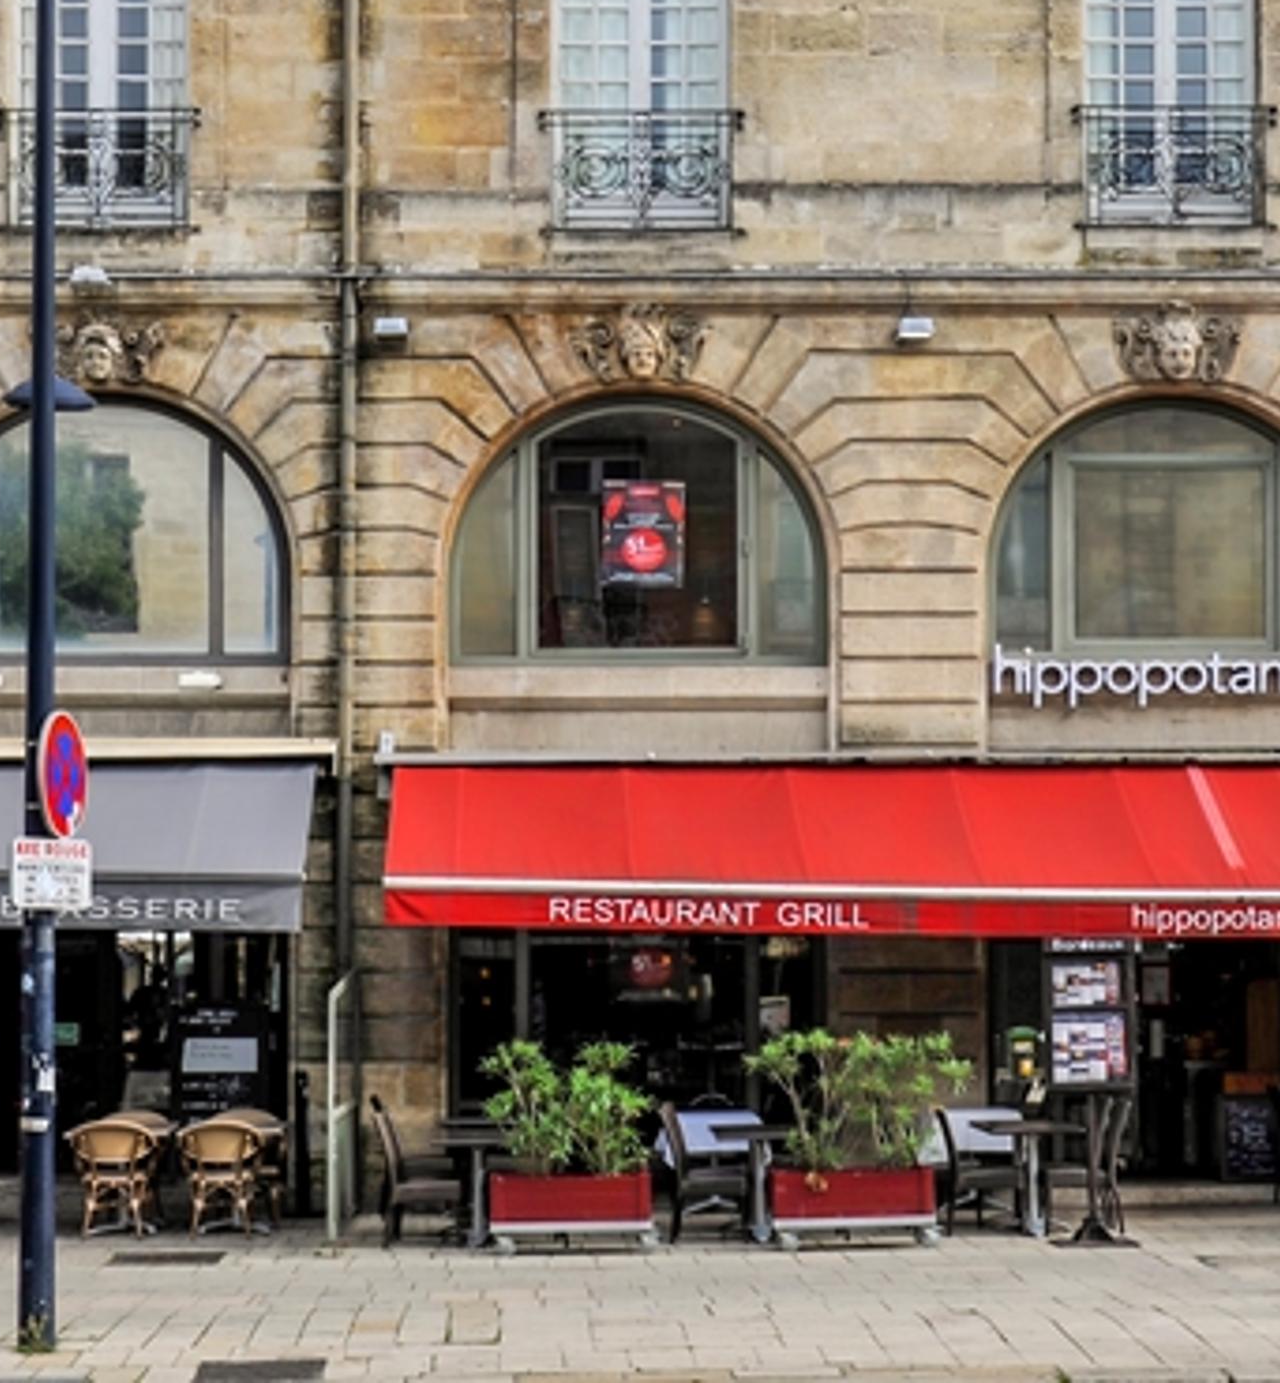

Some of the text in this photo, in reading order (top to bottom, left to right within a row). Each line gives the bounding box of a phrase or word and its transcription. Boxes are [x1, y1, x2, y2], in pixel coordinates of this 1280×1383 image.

[1, 894, 241, 920] BSSERIE
[547, 898, 869, 929] RESTAURANT GRILL
